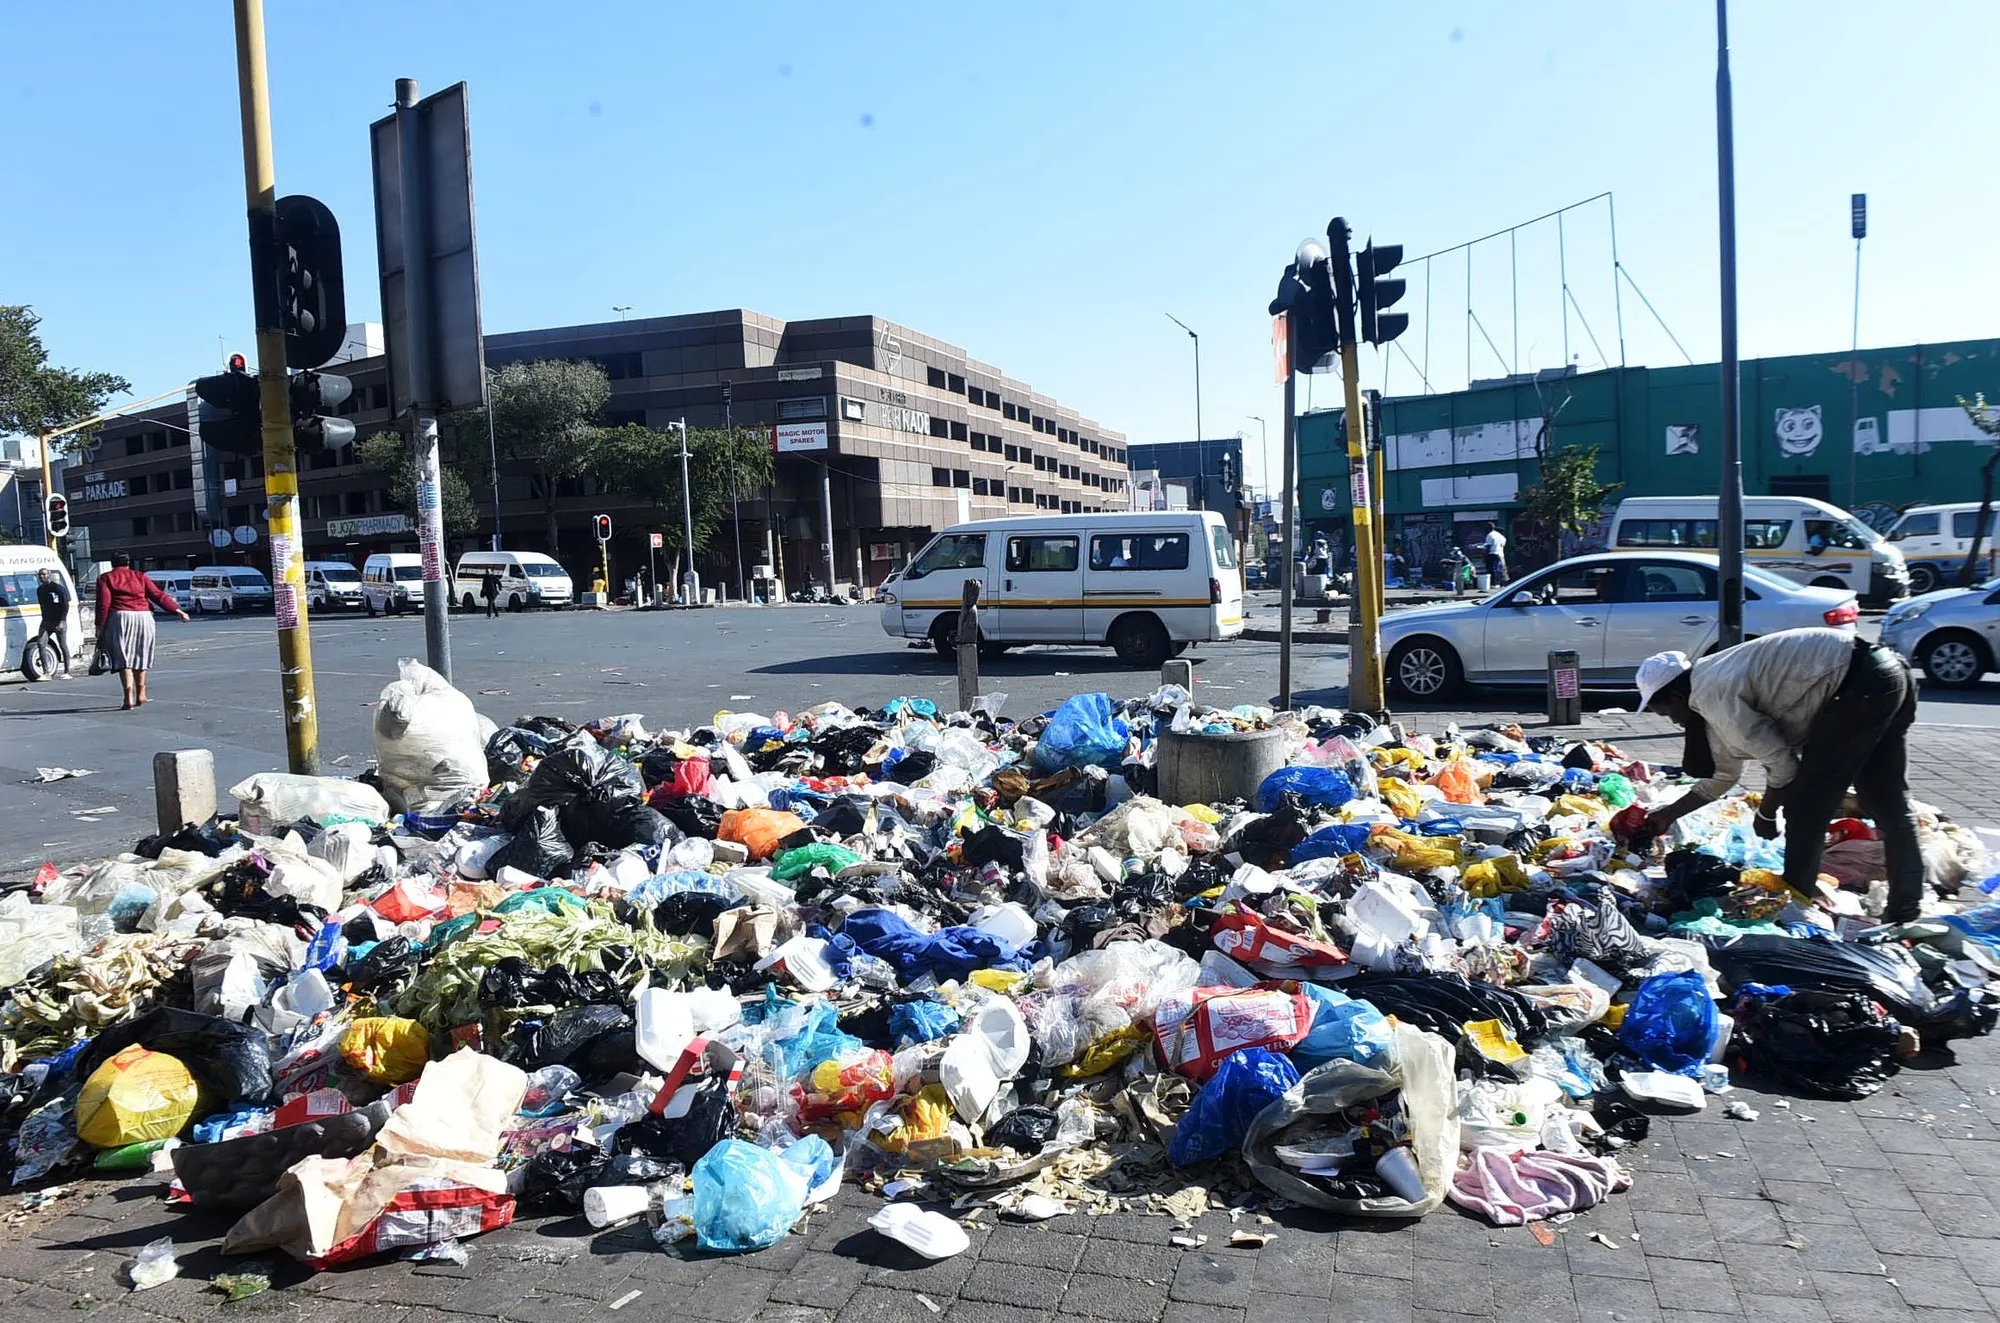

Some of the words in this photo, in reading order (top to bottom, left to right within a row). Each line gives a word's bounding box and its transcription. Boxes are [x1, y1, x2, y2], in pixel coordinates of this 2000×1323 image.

[789, 437, 815, 445] SPARES
[85, 480, 126, 502] PARKADE
[338, 520, 356, 534] JOZI
[358, 516, 404, 534] PHARMACY
[9, 557, 55, 565] MNGONI
[429, 542, 441, 581] ABORTION
[286, 589, 298, 627] ABORTION
